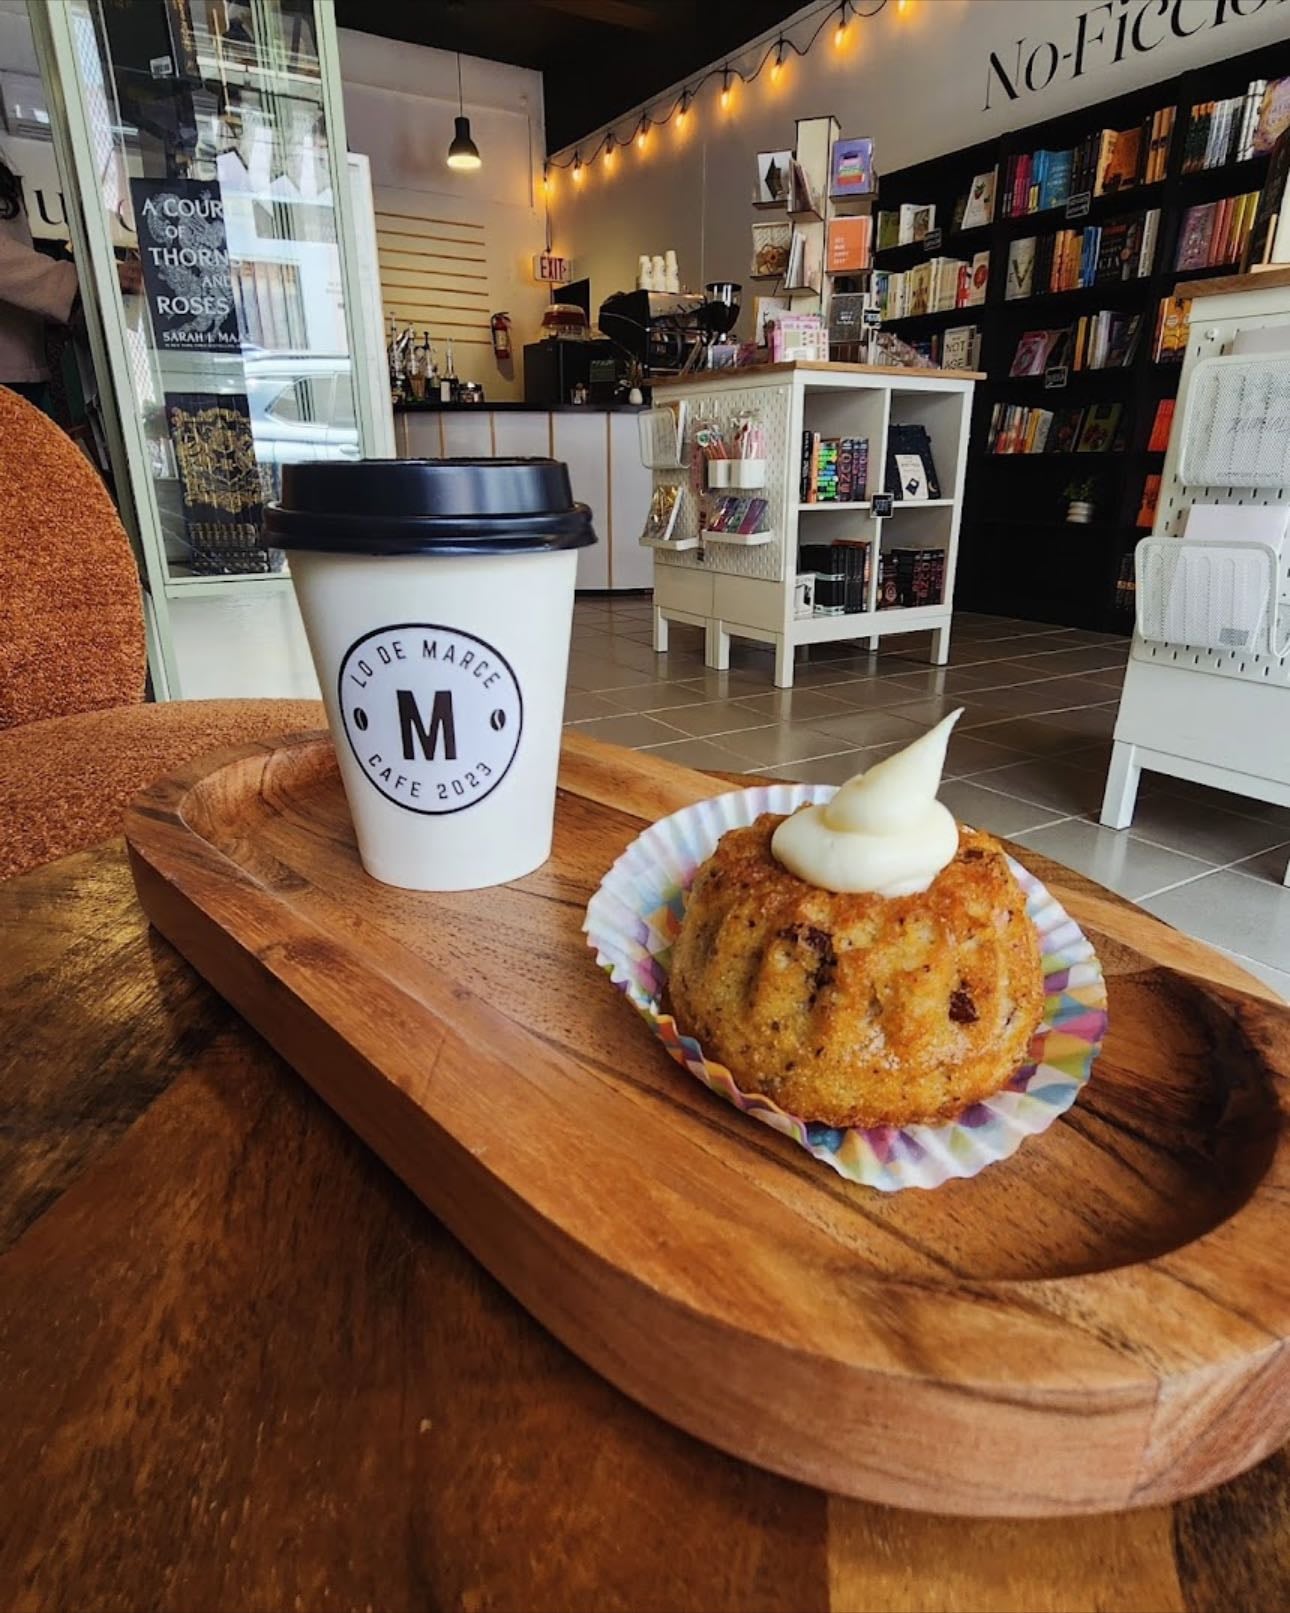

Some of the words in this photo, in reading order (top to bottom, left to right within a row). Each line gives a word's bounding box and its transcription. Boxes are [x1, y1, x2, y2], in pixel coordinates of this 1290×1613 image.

[982, 0, 1290, 111] No-Ficci
[142, 198, 158, 216] A
[164, 199, 225, 218] COUR
[165, 225, 185, 239] OF
[540, 256, 563, 281] EXIT
[157, 295, 230, 316] ROSES
[163, 331, 203, 343] SARAH
[350, 660, 373, 689] LO
[376, 641, 407, 665] DE
[422, 639, 501, 690] MARCE
[396, 689, 458, 762] M
[368, 753, 422, 798] CAFE
[436, 761, 493, 800] 2023
